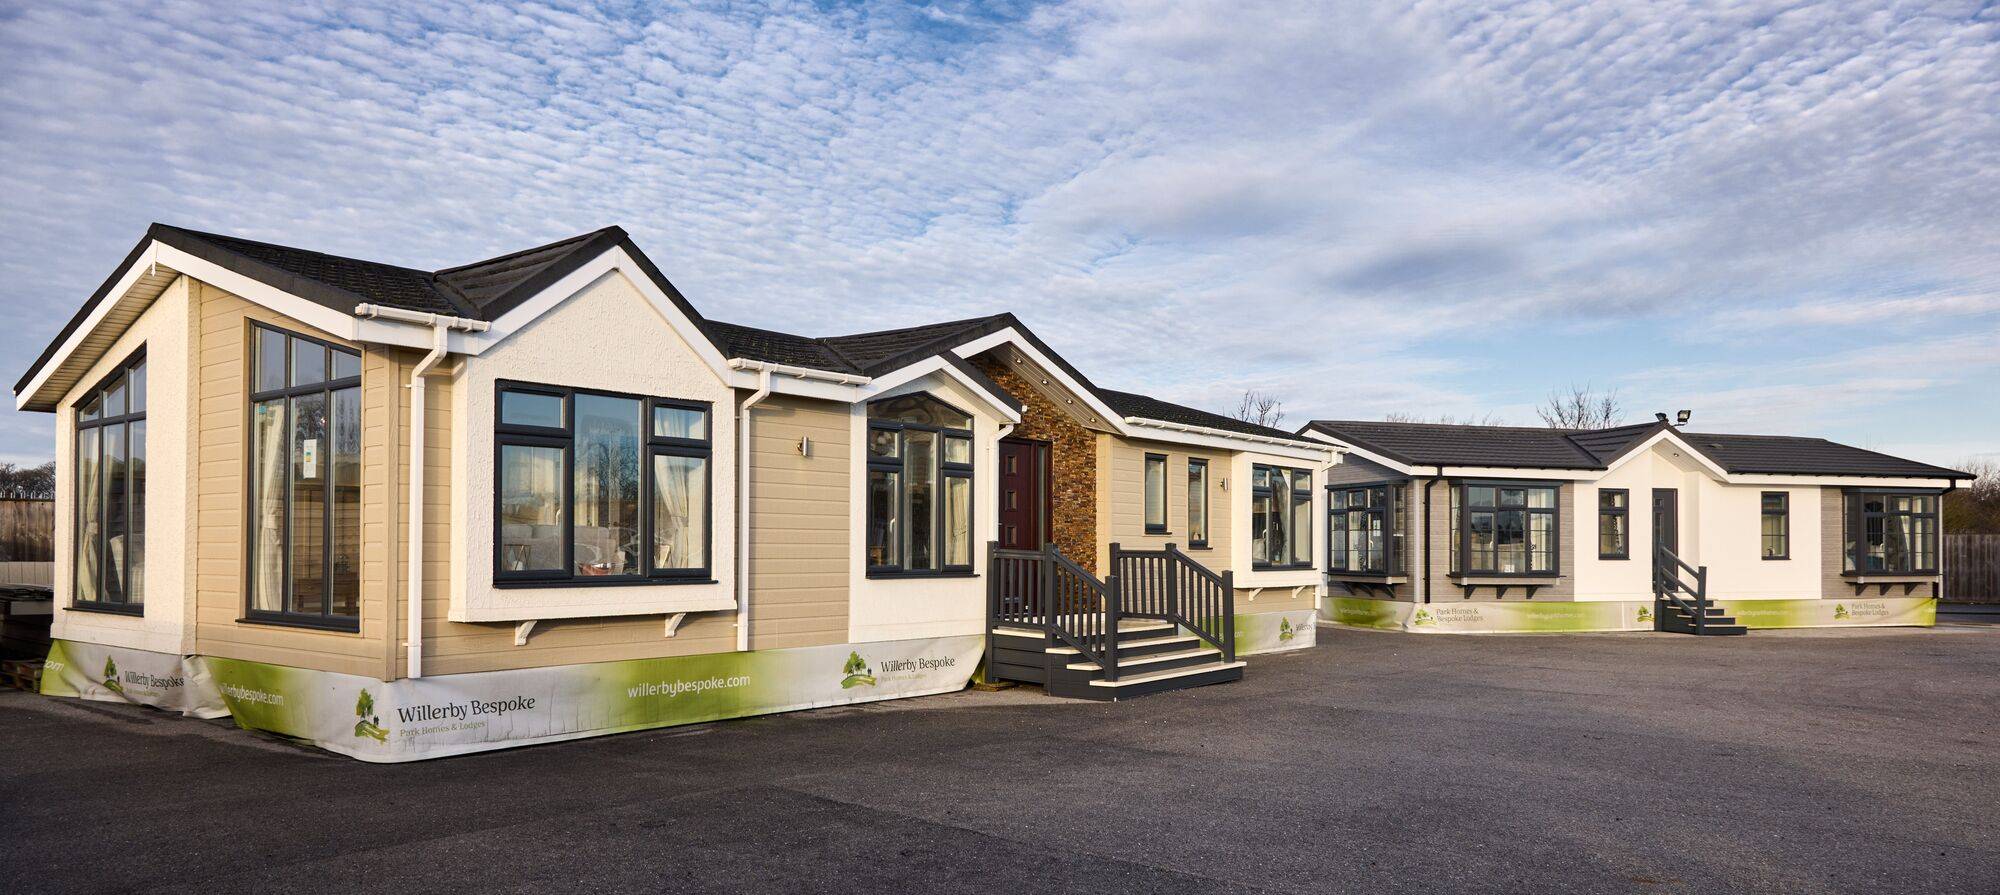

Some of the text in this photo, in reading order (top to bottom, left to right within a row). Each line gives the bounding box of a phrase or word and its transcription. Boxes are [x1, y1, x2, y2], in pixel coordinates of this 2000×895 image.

[880, 656, 955, 672] Willerby Bespoke
[627, 675, 751, 698] willerbybespoke.com
[397, 695, 536, 723] Willerby Bespoke
[400, 720, 486, 737] Park Homes & Lodges
